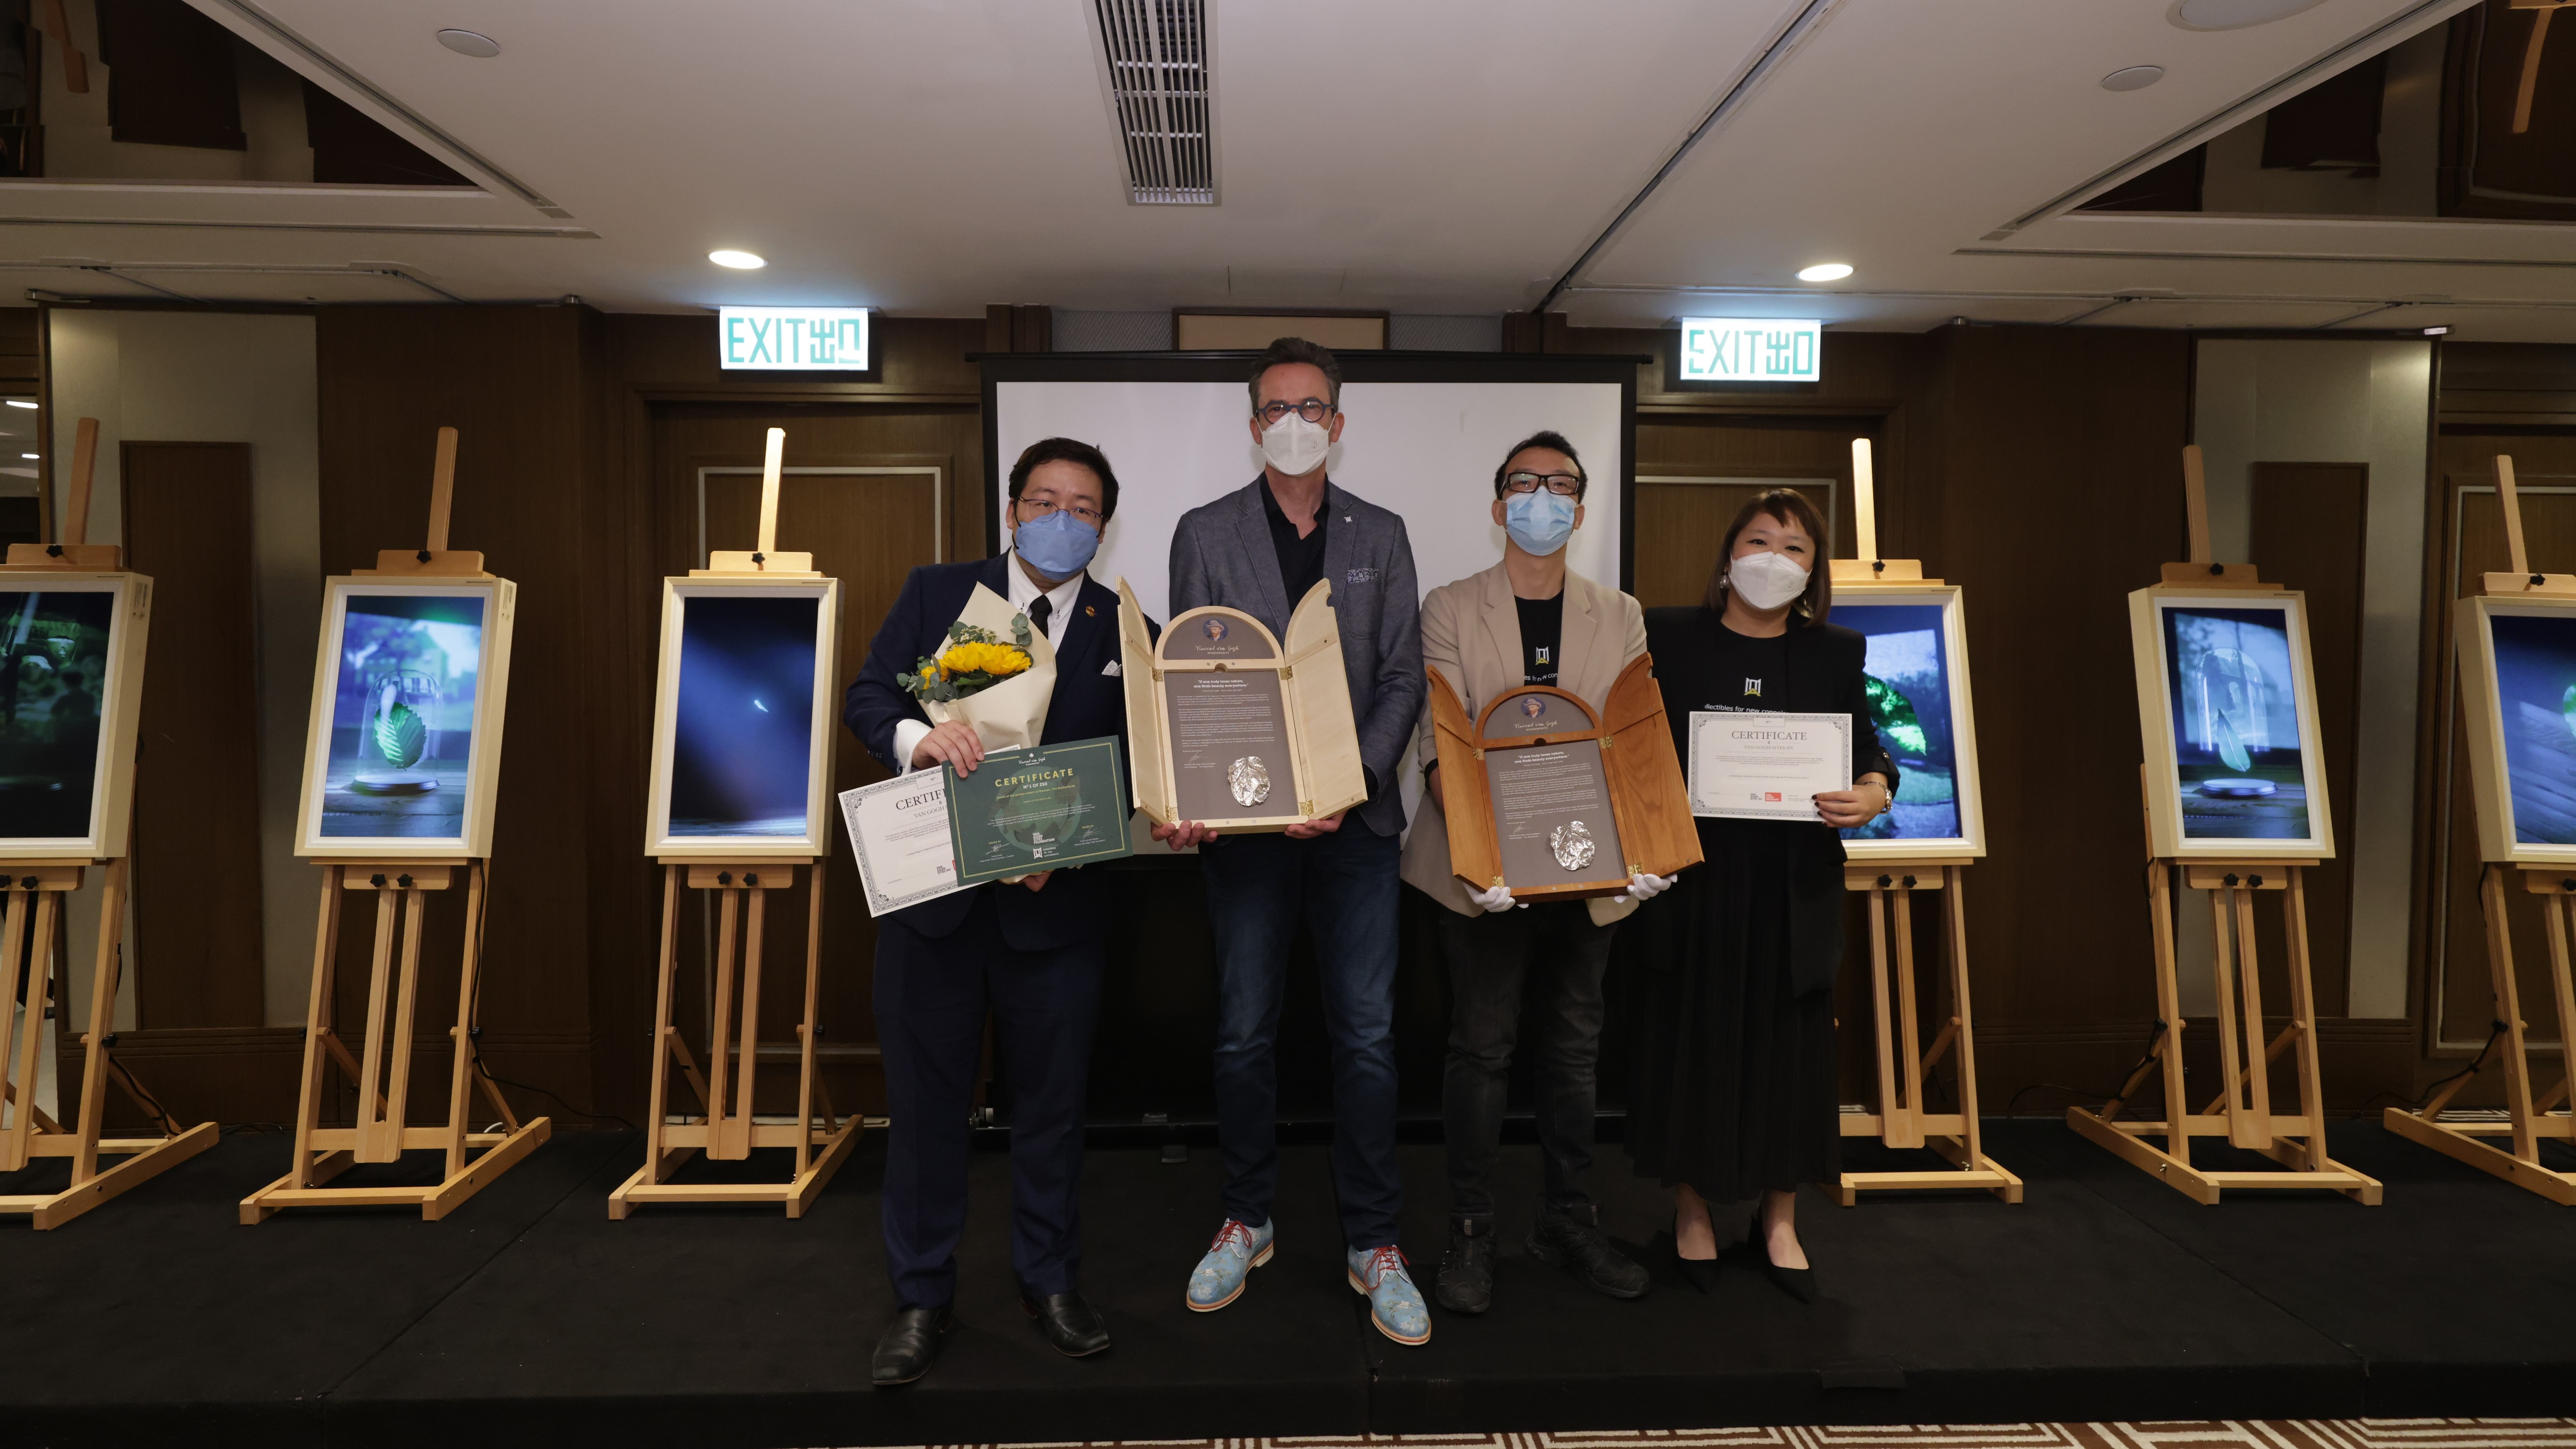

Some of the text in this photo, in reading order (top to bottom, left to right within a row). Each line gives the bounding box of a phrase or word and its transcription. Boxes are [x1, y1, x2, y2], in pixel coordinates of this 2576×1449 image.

[727, 317, 806, 363] EXIT
[809, 318, 860, 364] 出口
[1688, 329, 1763, 374] EXIT
[1766, 330, 1814, 375] 出口
[1732, 731, 1808, 740] CERTIFICATE
[995, 768, 1074, 787] CERTIFICATE
[927, 805, 944, 815] GOGH
